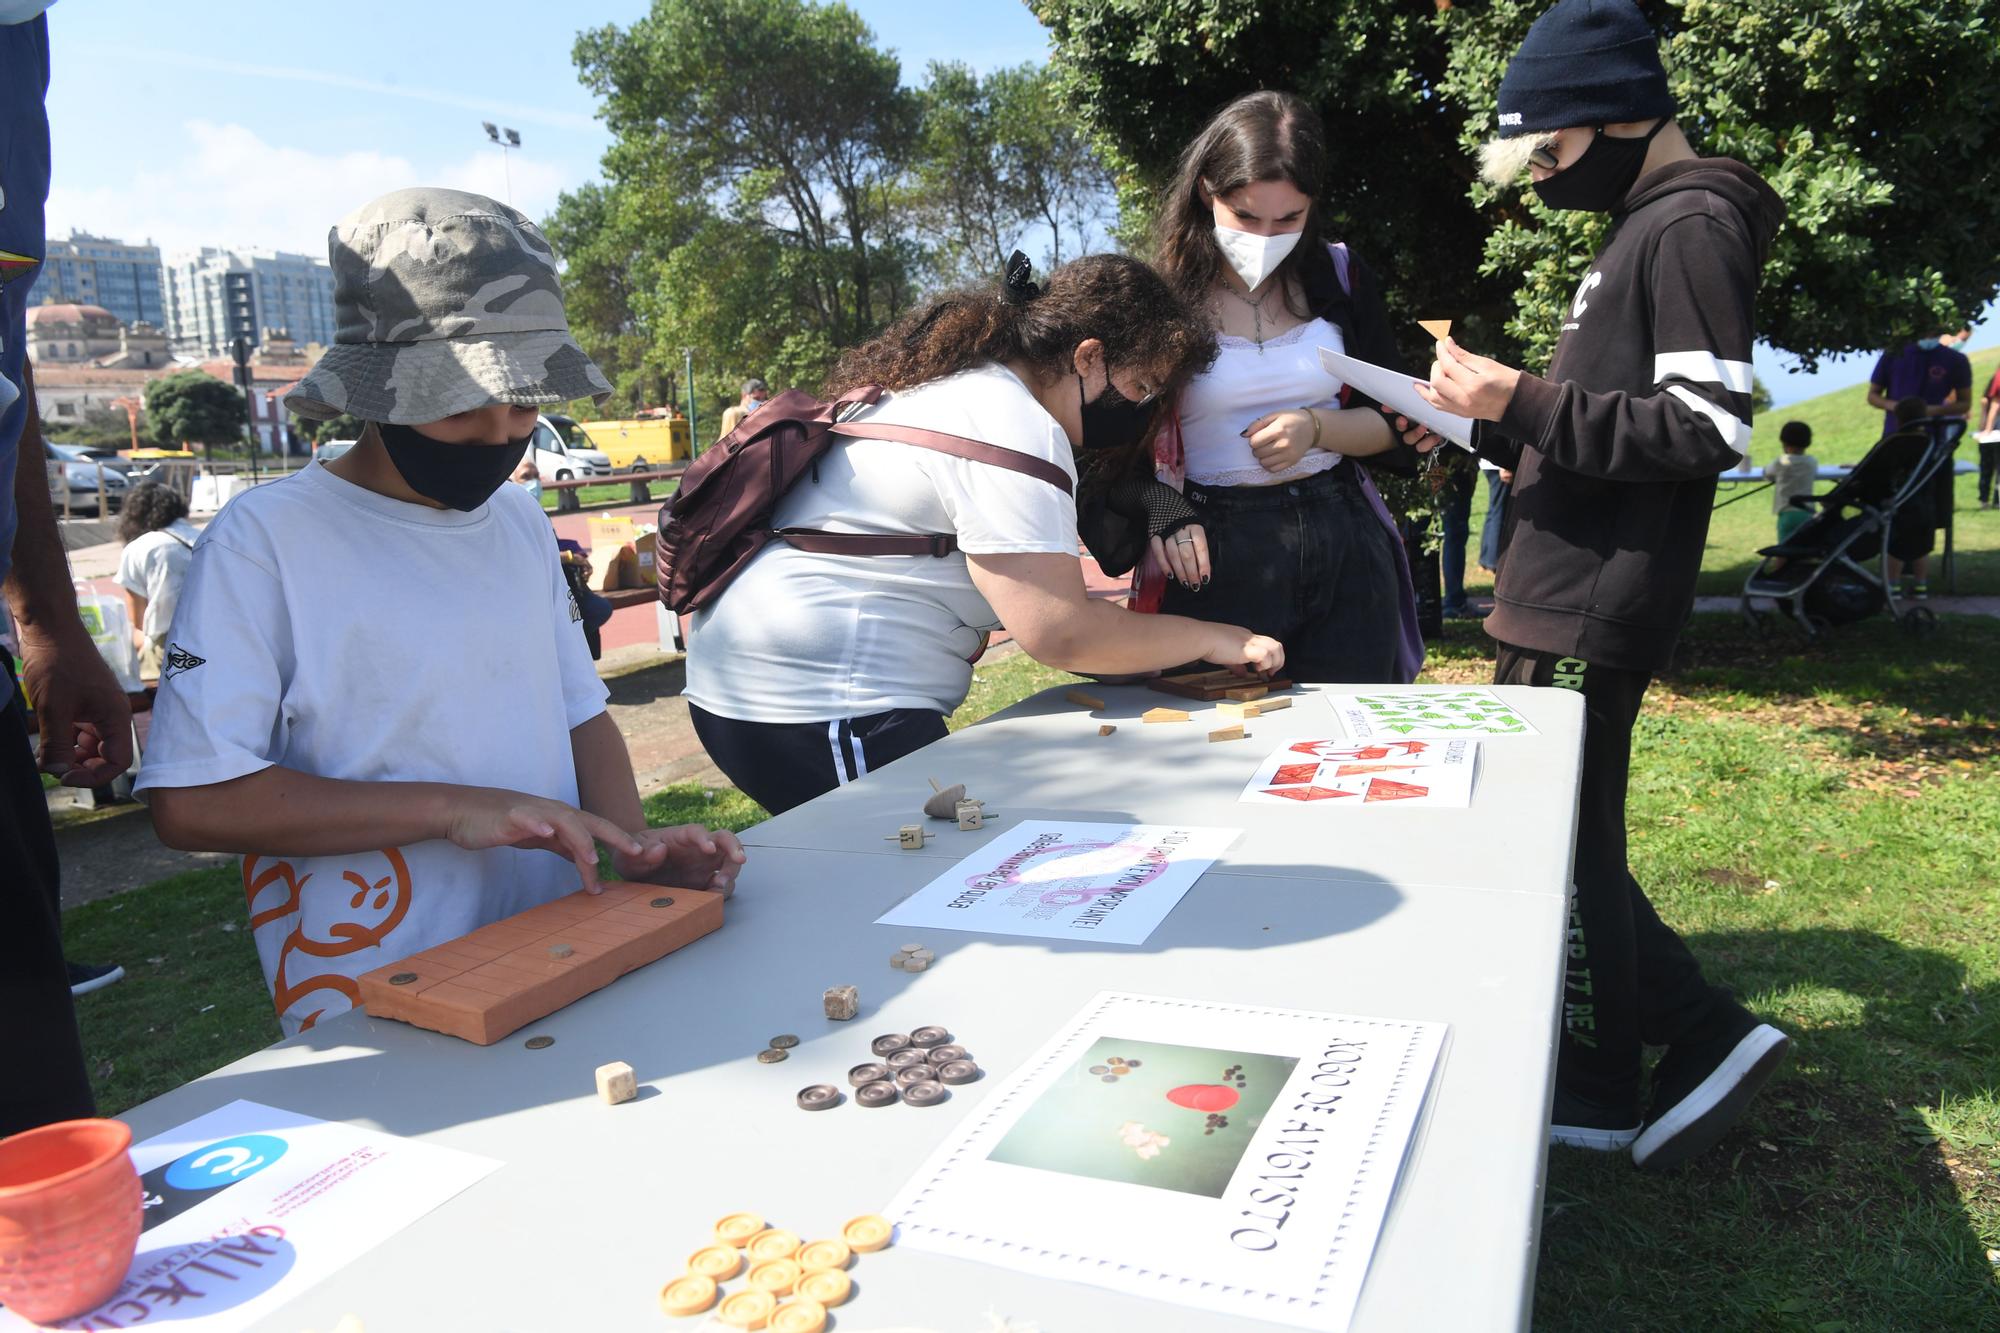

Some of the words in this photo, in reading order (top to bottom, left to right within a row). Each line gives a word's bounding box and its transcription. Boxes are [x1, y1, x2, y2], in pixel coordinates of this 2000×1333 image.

[1573, 271, 1602, 319] C
[1551, 656, 1588, 691] CR
[1115, 873, 1149, 887] MOI
[1069, 887, 1135, 929] IMPORTANTE!
[1310, 1037, 1368, 1087] XOGO
[1293, 1091, 1343, 1115] DE
[1230, 1119, 1325, 1252] AVGVSTO
